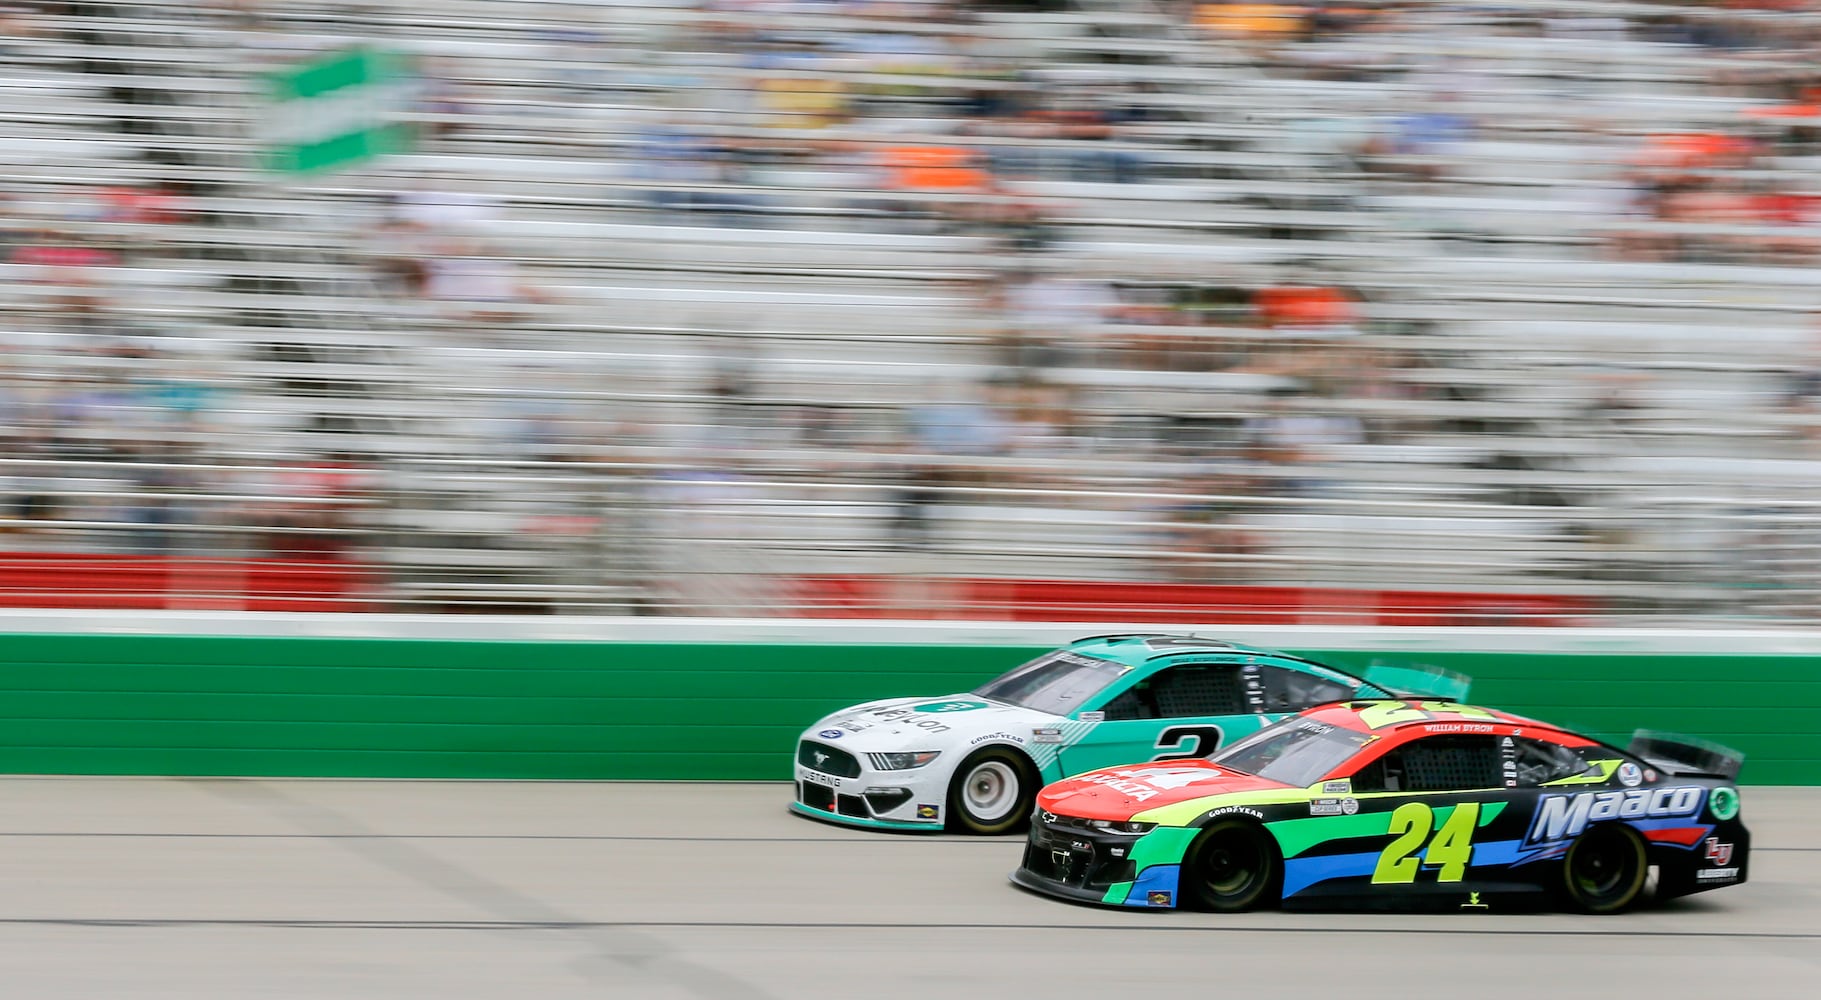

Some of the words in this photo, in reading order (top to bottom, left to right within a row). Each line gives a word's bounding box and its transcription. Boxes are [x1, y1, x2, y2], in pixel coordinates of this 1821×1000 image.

[1424, 724, 1461, 733] WILLIAM
[1463, 724, 1494, 733] BYRON
[1531, 787, 1702, 841] Maaco
[1371, 802, 1480, 884] 24
